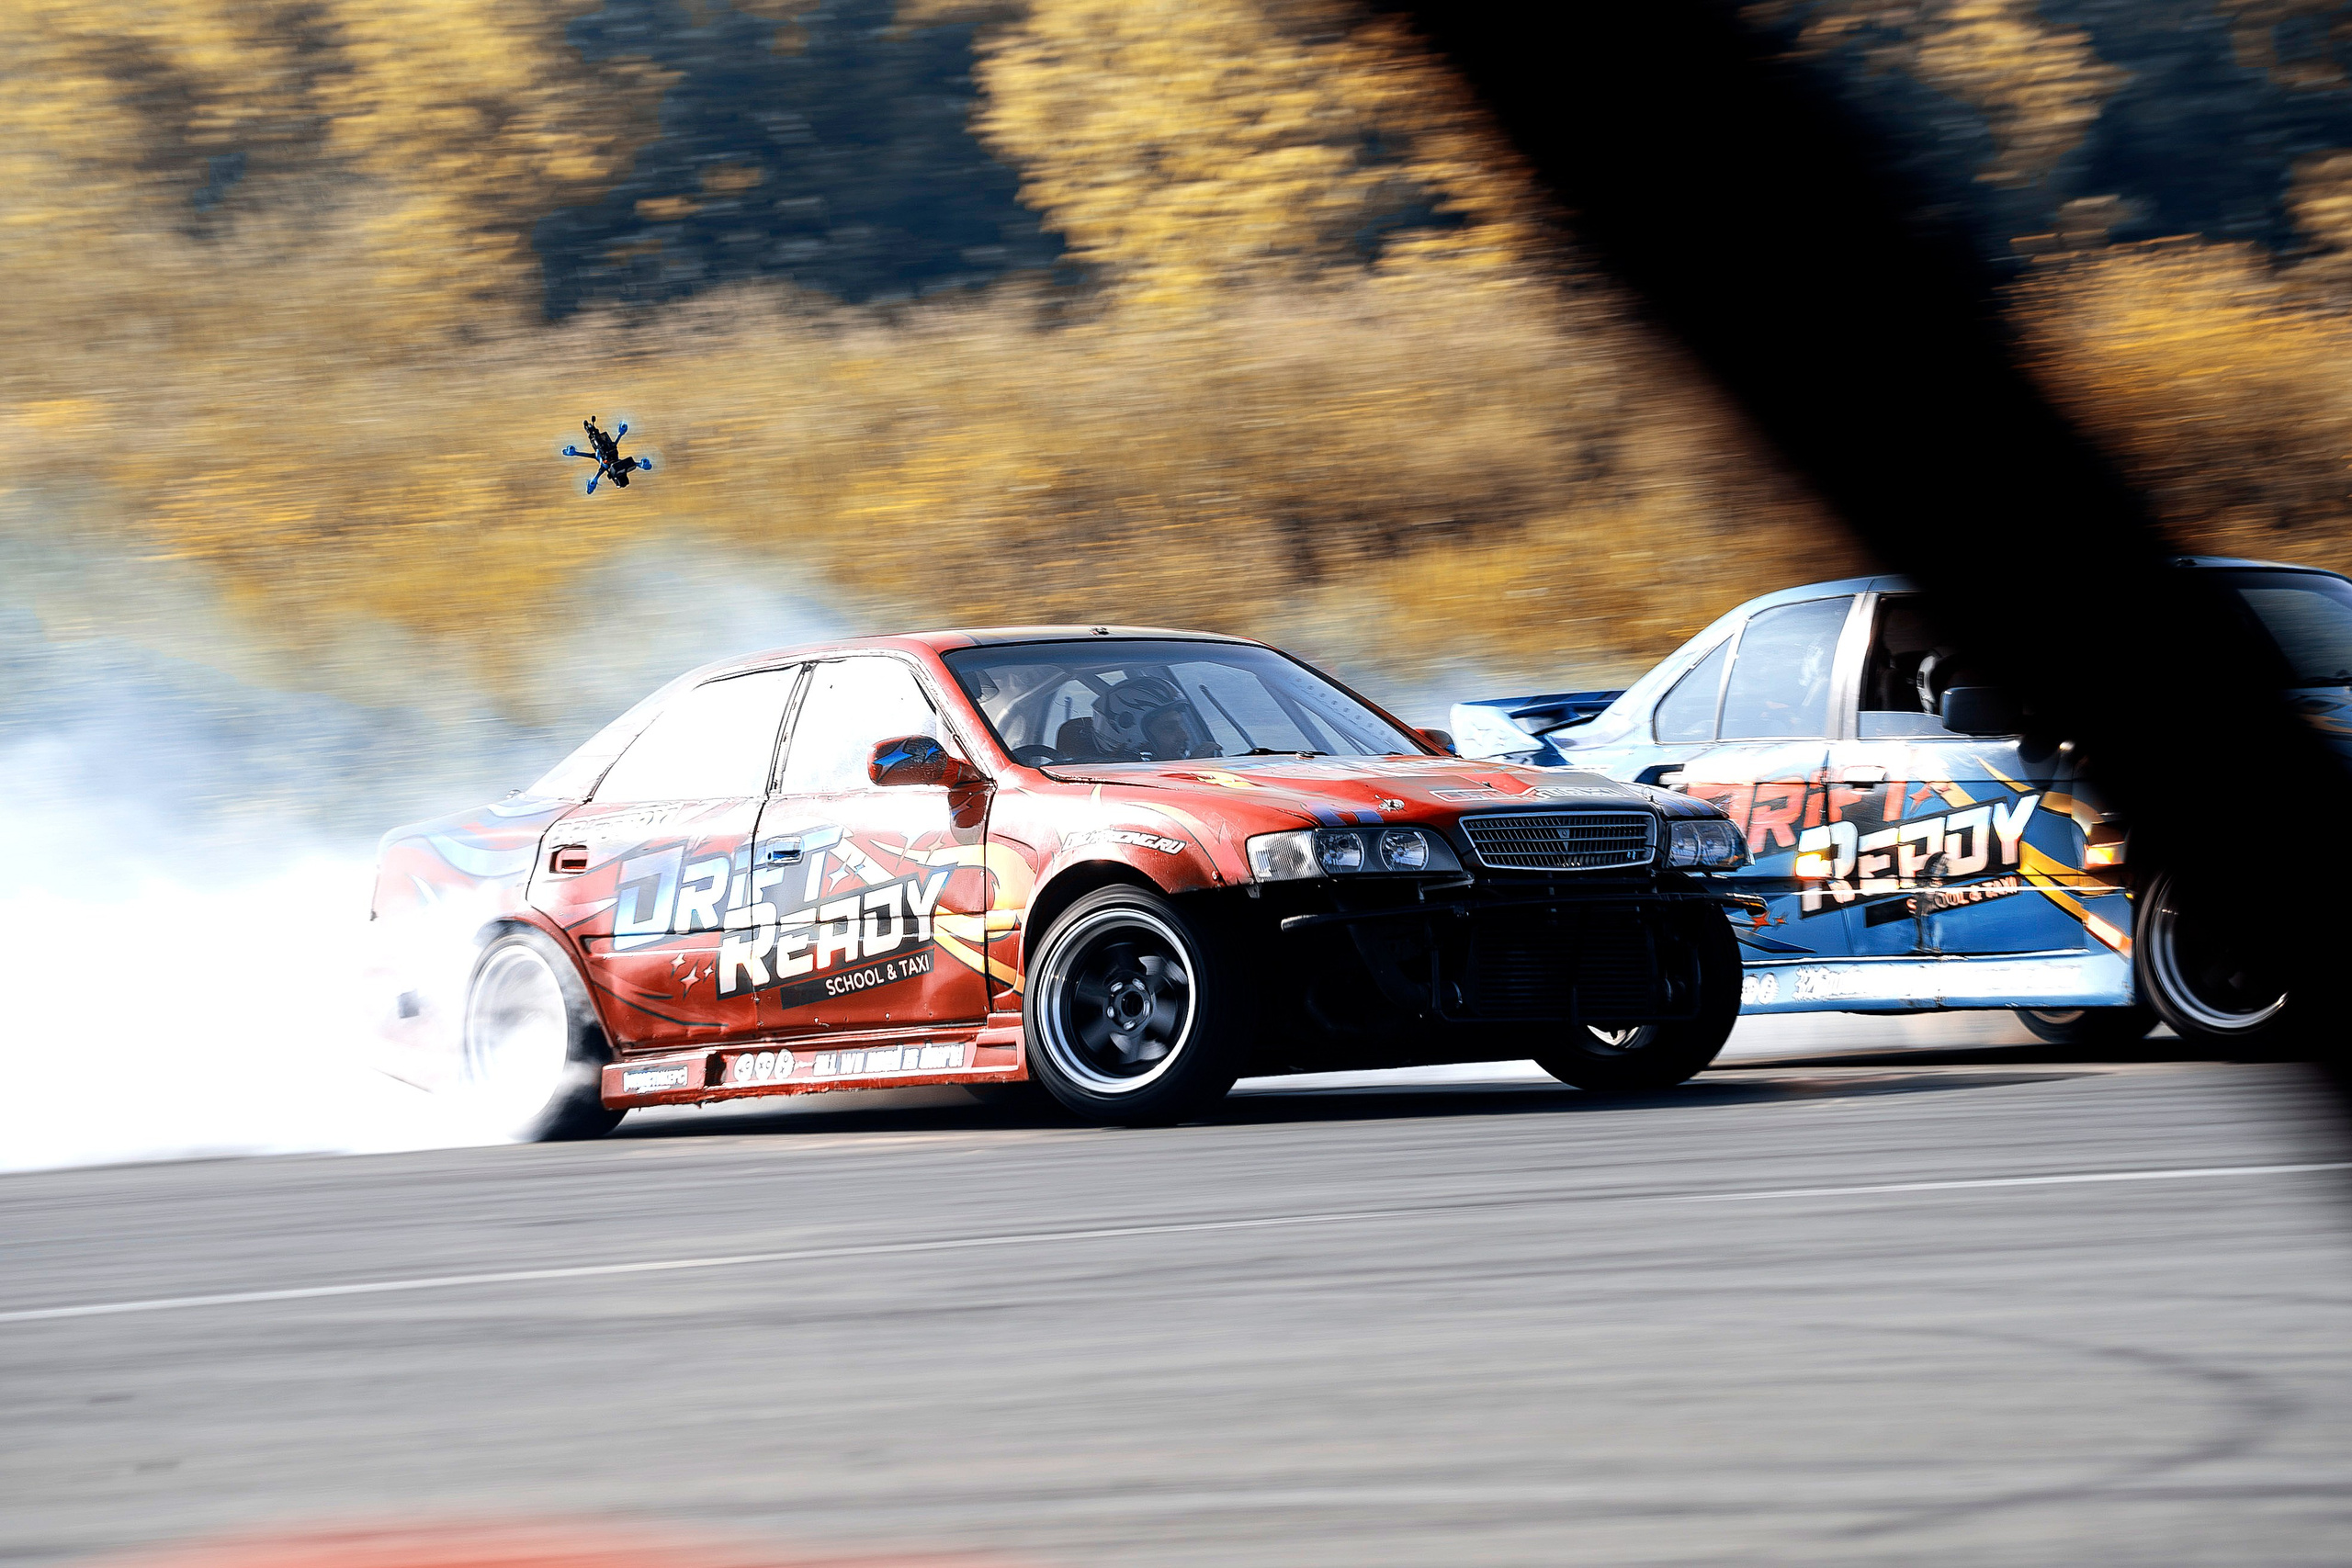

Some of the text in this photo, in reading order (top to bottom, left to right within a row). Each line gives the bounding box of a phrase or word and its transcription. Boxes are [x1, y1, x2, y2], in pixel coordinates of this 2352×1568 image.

[614, 827, 844, 951] DRIFT
[719, 871, 951, 994] READY
[825, 953, 930, 996] SCHOOL & TAXI
